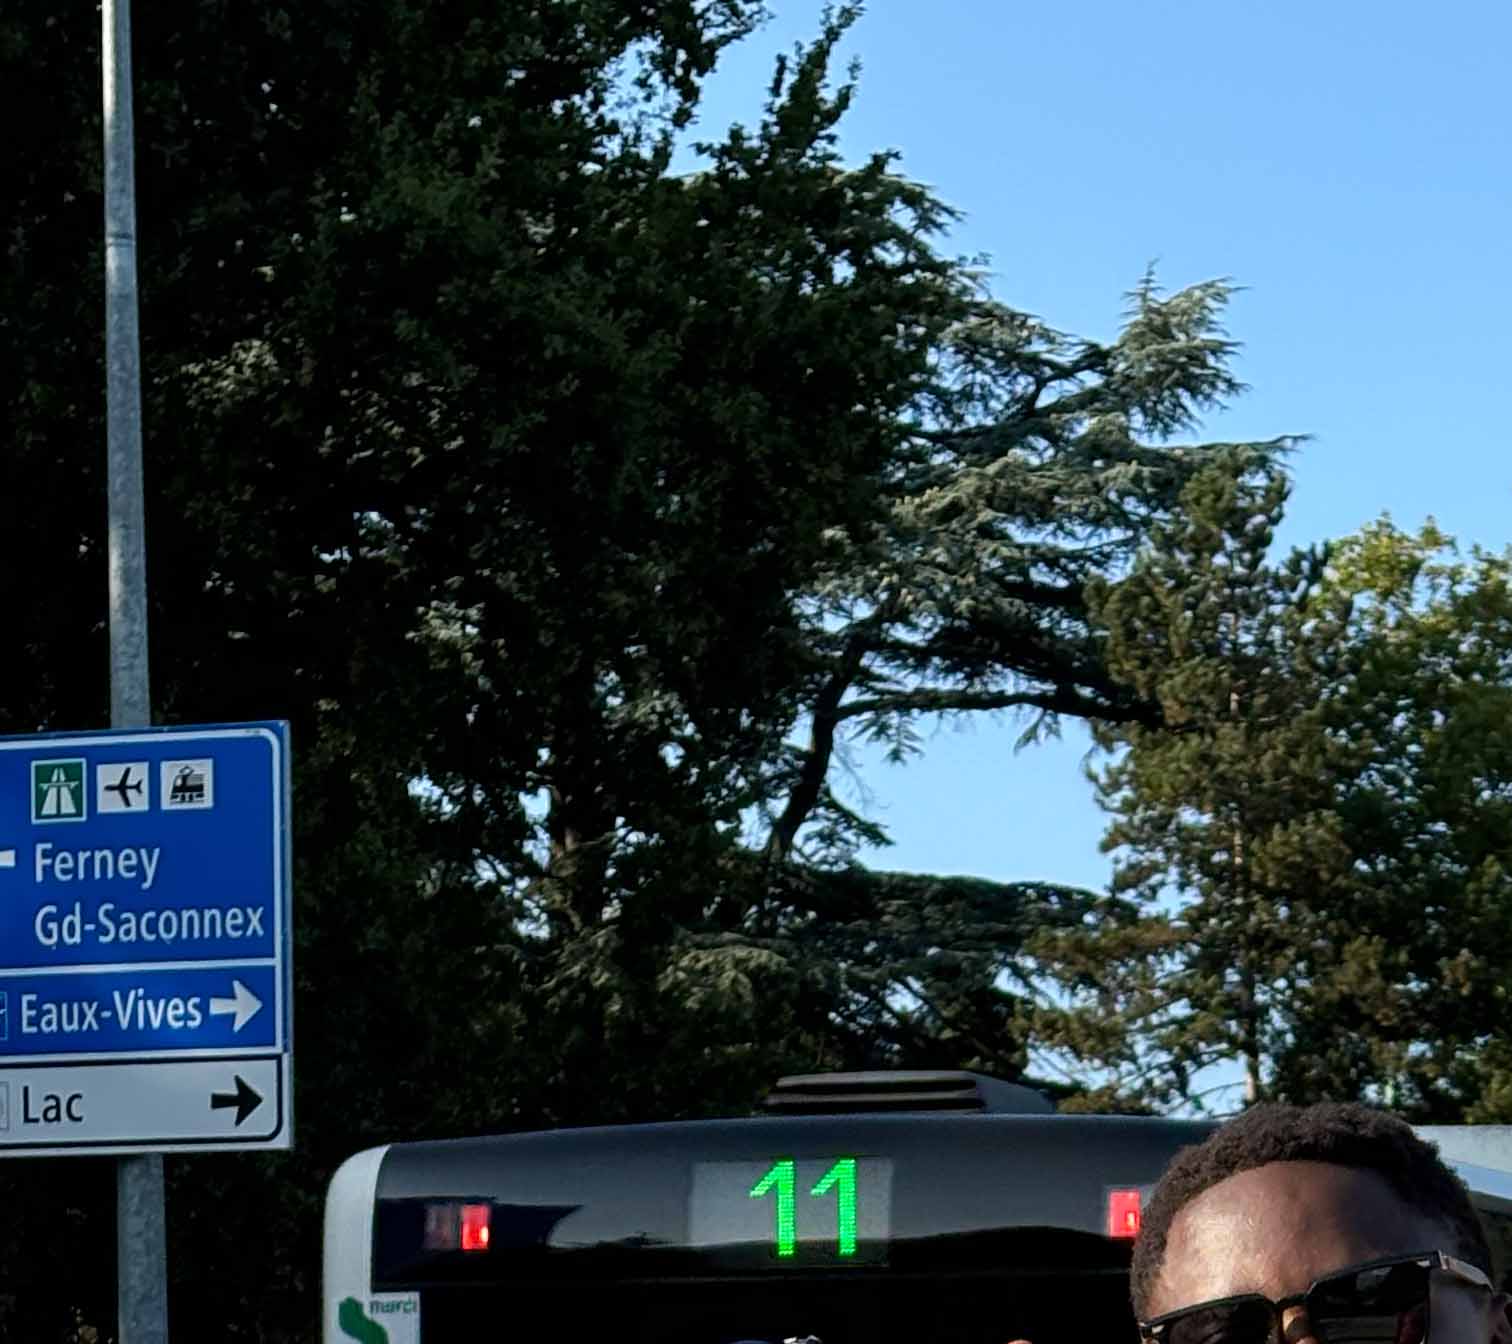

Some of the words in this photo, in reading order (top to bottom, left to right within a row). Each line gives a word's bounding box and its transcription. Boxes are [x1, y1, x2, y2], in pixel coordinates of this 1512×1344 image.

[34, 841, 160, 889] Ferney
[34, 901, 264, 947] Gd-Saconnex
[20, 988, 203, 1034] Eaux-Vives
[22, 1085, 84, 1124] Lac
[749, 1158, 857, 1256] 11
